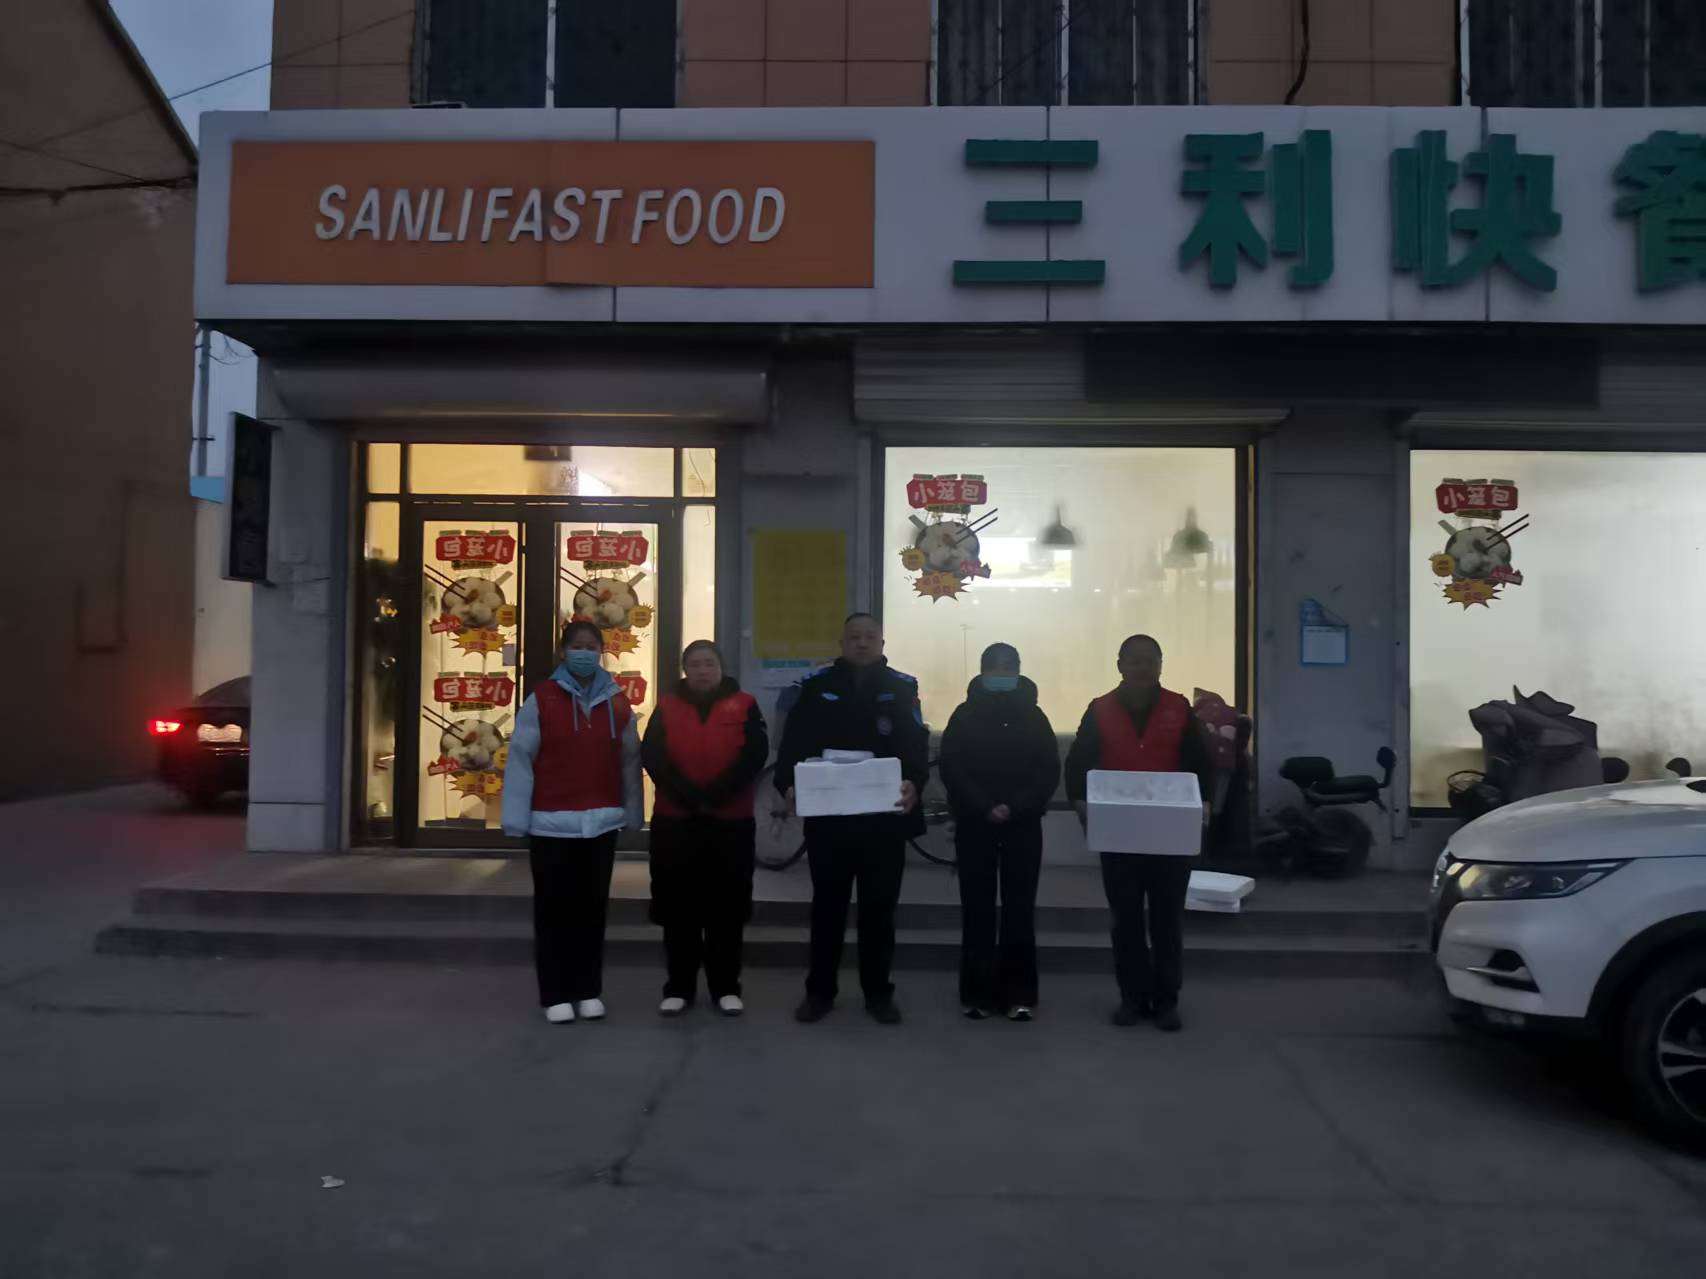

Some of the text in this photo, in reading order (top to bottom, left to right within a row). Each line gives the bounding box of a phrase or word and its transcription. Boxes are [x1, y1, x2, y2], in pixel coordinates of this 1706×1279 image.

[315, 184, 786, 246] SANLI FAST FOOD
[953, 129, 1706, 293] 三利快餐
